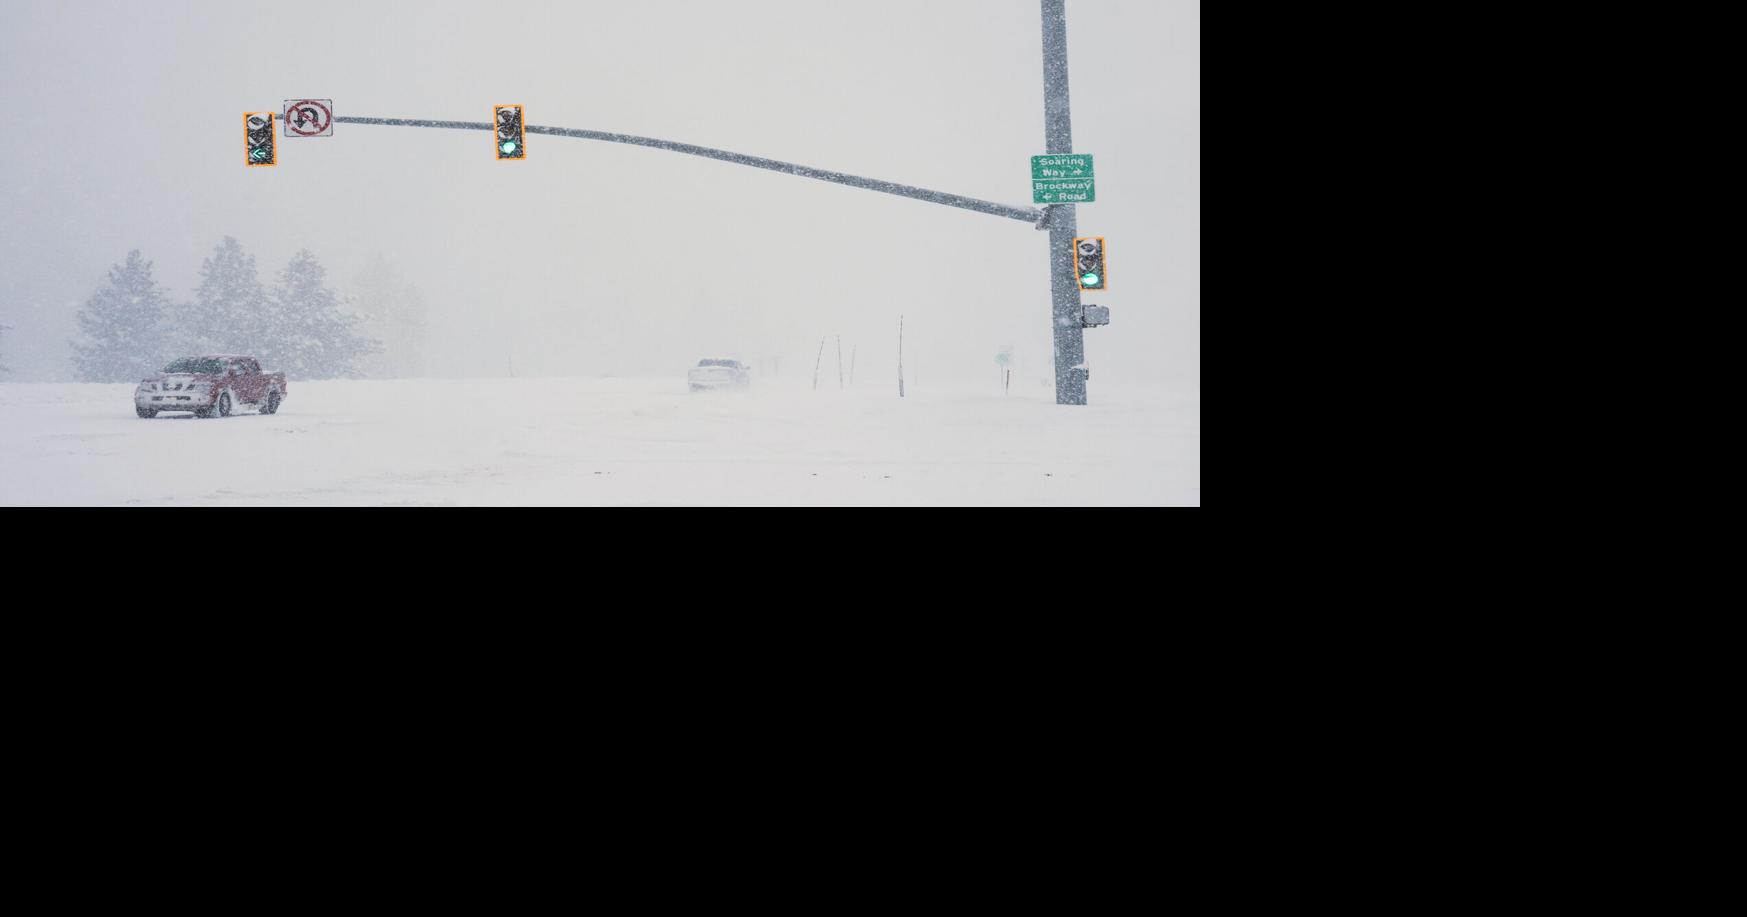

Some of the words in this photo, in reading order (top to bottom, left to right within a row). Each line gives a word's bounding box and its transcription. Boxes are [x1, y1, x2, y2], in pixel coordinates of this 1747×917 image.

[1040, 157, 1084, 166] Soaring
[1042, 169, 1066, 177] Way
[1035, 182, 1091, 190] Brockway
[1059, 192, 1087, 200] Road
